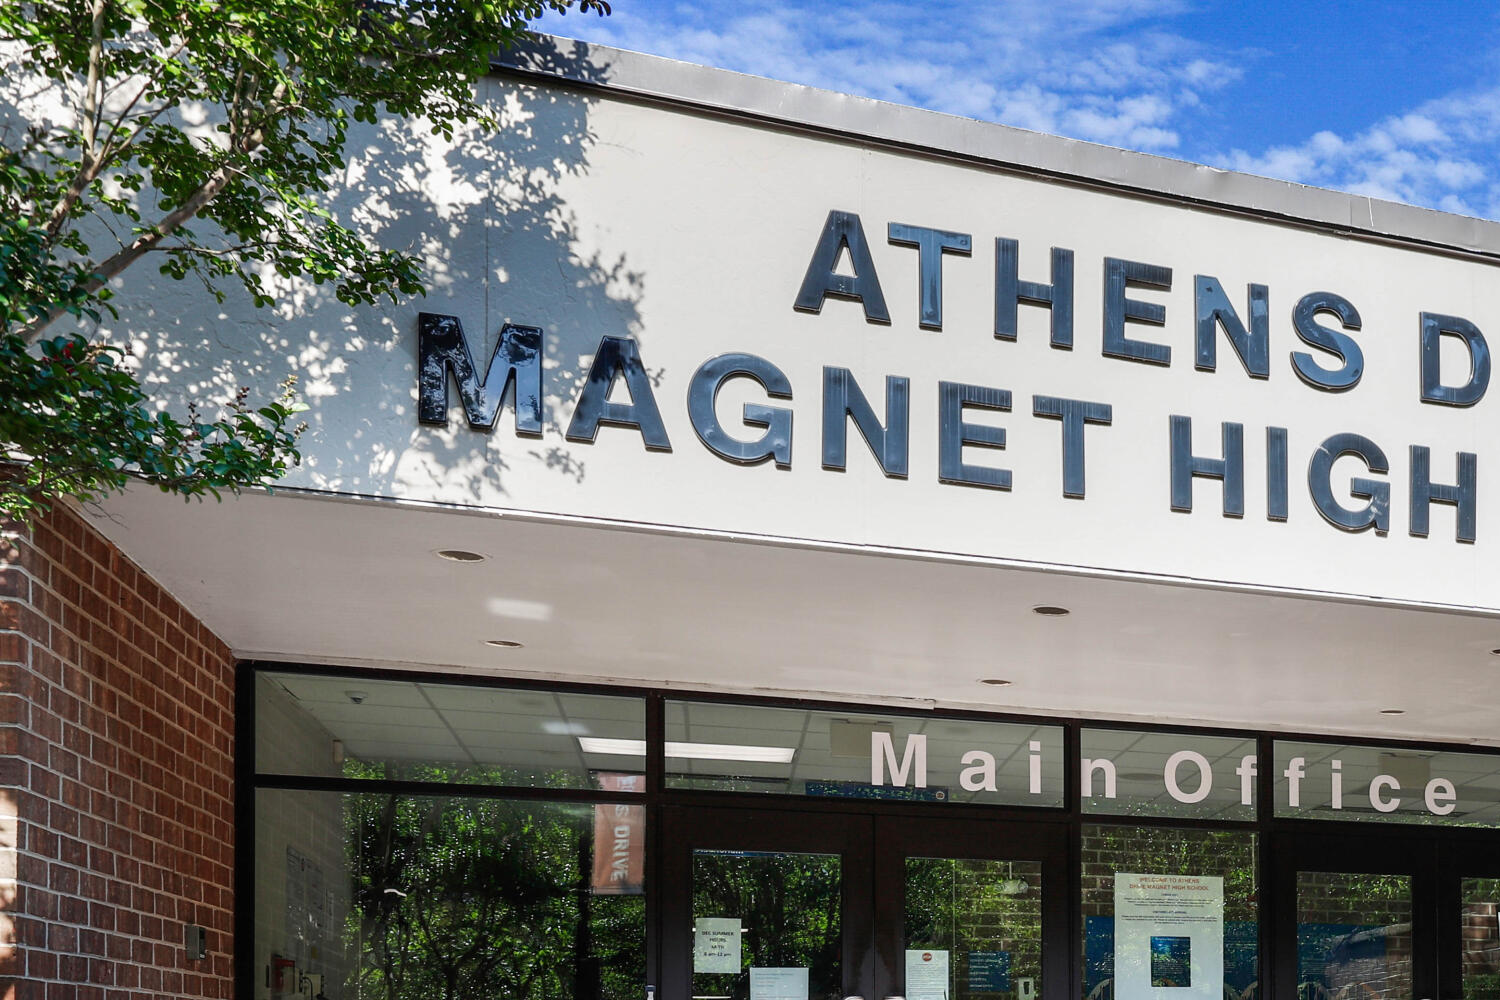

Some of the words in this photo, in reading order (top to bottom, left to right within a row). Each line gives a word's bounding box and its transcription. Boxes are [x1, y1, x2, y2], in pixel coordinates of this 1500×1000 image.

[793, 208, 1364, 392] ATHENS
[418, 311, 1113, 501] MAGNET
[1169, 414, 1477, 544] HIGH
[871, 731, 1117, 800] Main
[1164, 750, 1458, 817] Office
[610, 825, 631, 882] DRIVE
